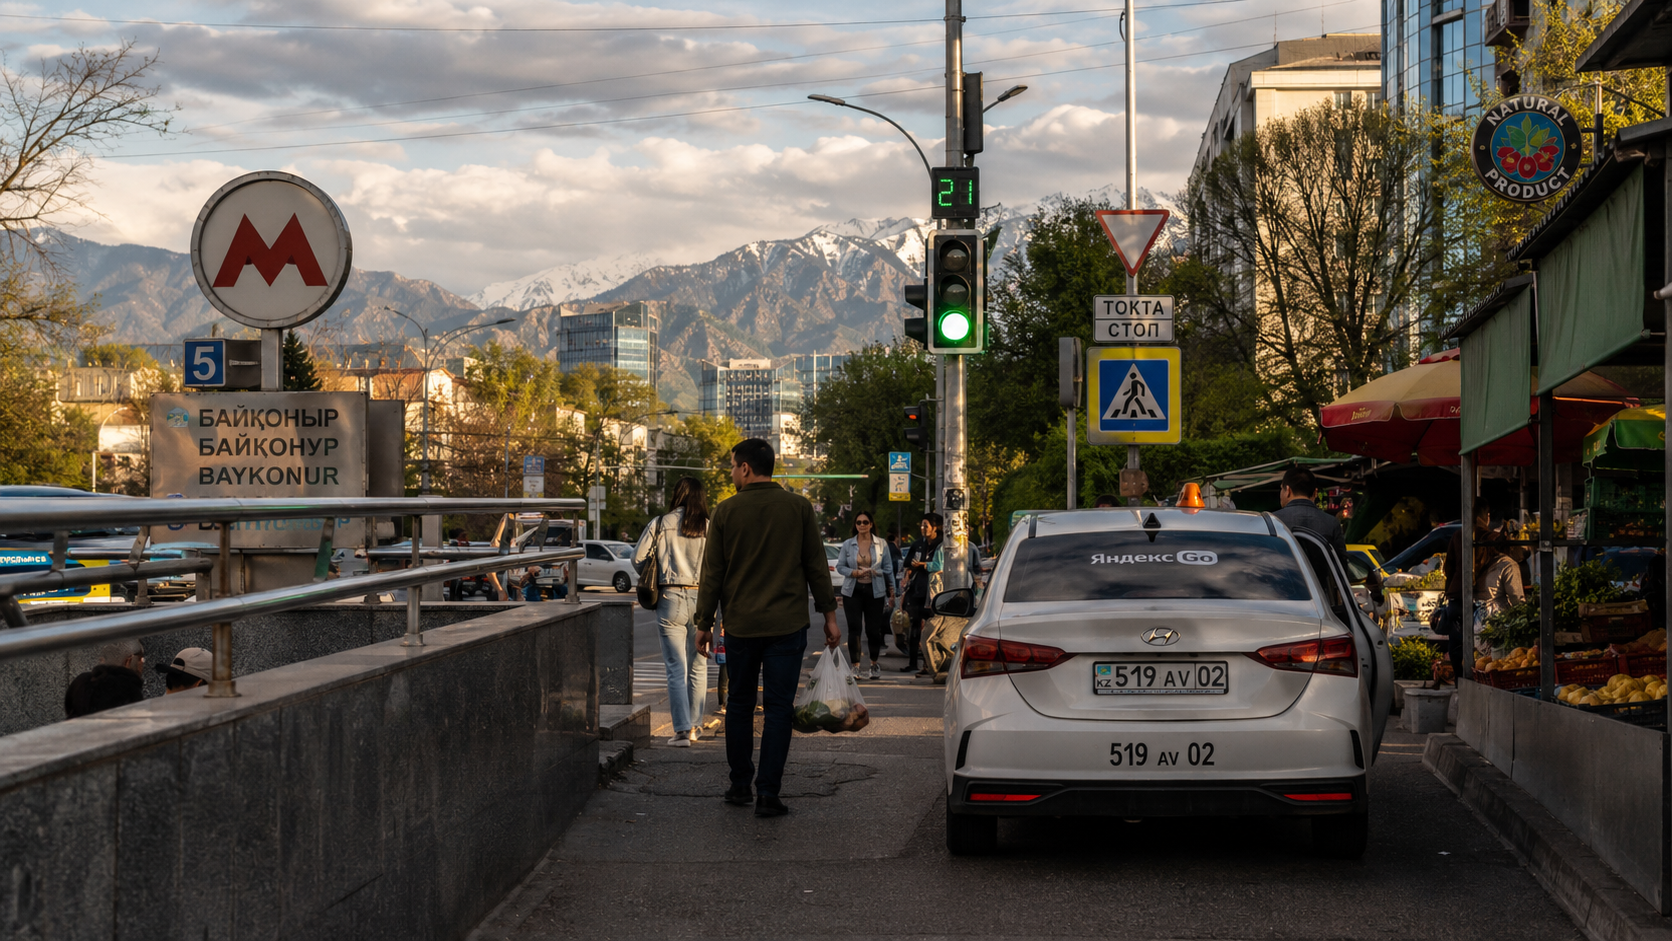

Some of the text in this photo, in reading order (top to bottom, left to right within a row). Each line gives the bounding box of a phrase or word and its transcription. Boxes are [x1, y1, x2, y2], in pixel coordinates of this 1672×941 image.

[1486, 96, 1569, 126] NATURAL
[938, 178, 973, 207] 21
[1485, 166, 1571, 198] PRODUCT
[1103, 300, 1164, 315] ТОКТА
[1108, 322, 1159, 338] СТОП
[193, 346, 217, 381] 5
[199, 404, 339, 430] БАЙҚОНЫР
[199, 466, 340, 485] BAYKONUR
[1090, 551, 1216, 566] Яндекс Go
[1096, 665, 1225, 688] KZ 519 AV 02
[1109, 742, 1215, 766] 519 AV 02
